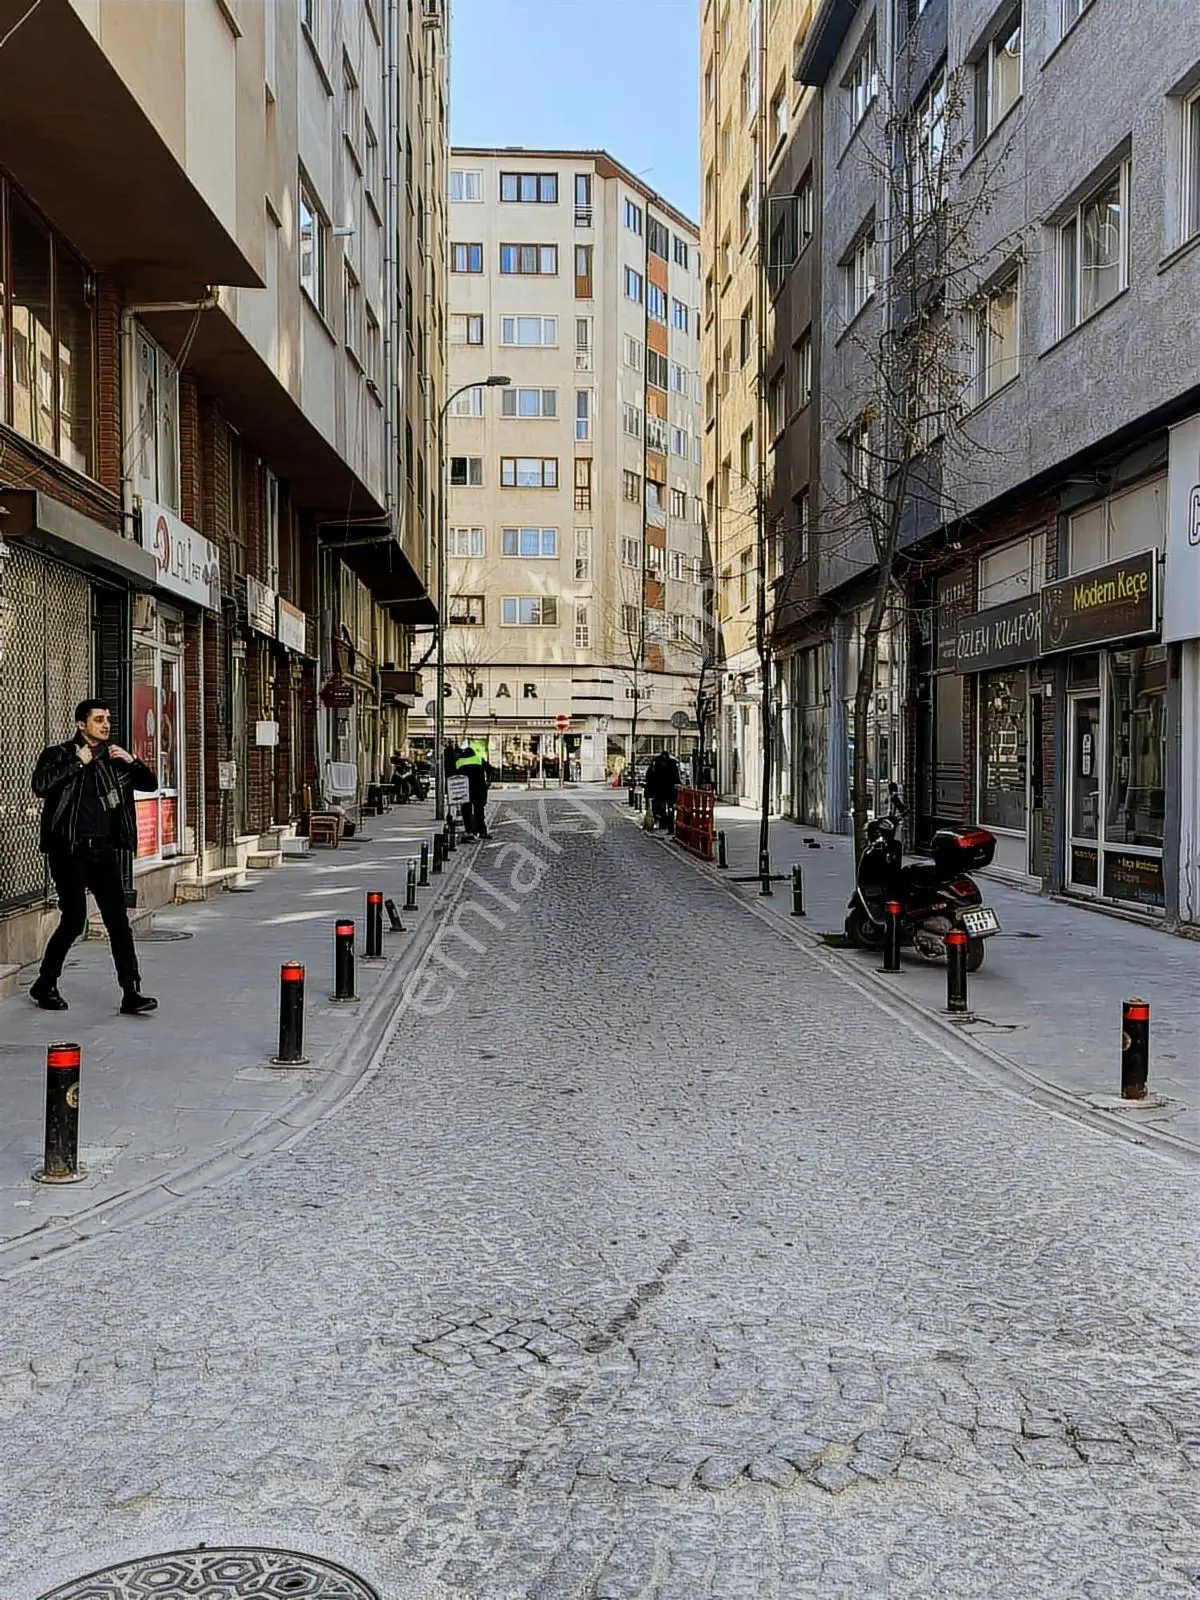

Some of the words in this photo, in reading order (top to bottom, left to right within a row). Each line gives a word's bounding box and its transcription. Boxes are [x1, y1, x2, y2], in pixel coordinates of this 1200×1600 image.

[1073, 581, 1116, 612] Modern
[1117, 570, 1149, 604] Keçe
[957, 626, 990, 659] ÖZLEM
